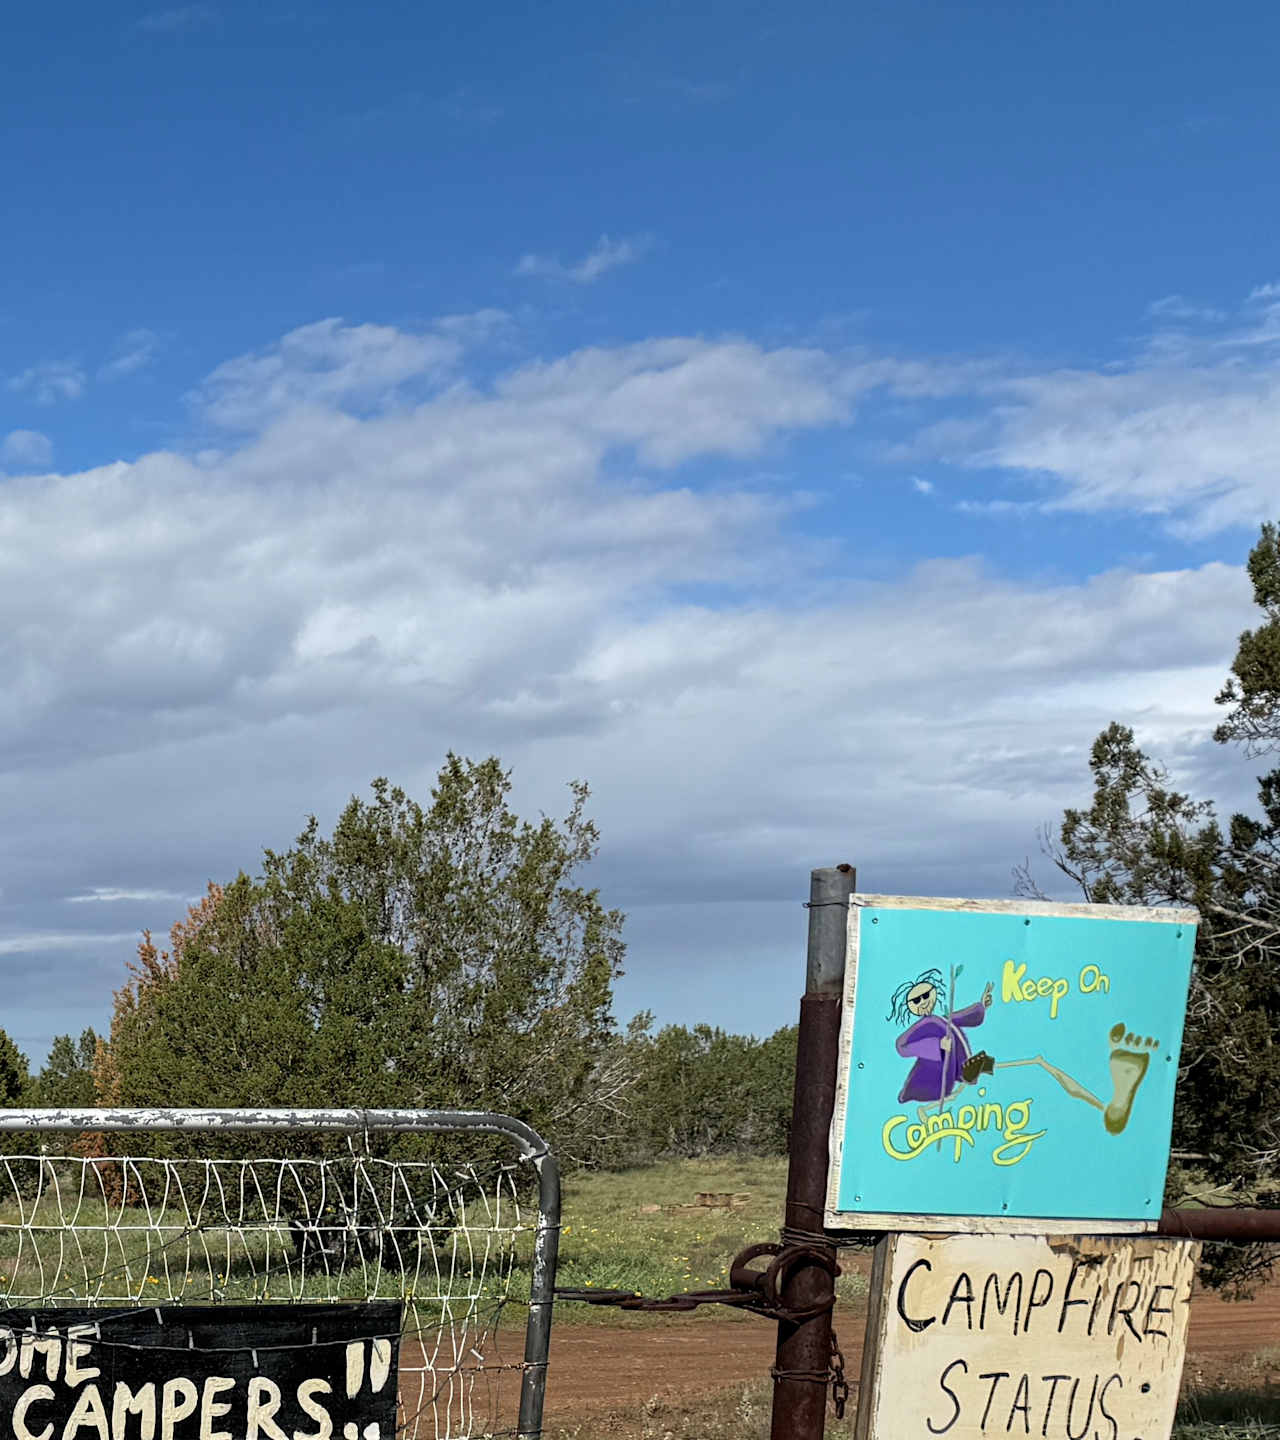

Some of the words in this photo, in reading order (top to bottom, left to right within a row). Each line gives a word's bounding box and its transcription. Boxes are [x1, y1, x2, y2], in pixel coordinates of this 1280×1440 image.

[1001, 959, 1068, 1019] Keep
[1079, 964, 1110, 995] On
[882, 1087, 1048, 1166] Camping
[897, 1258, 1175, 1342] CAMPFIRE
